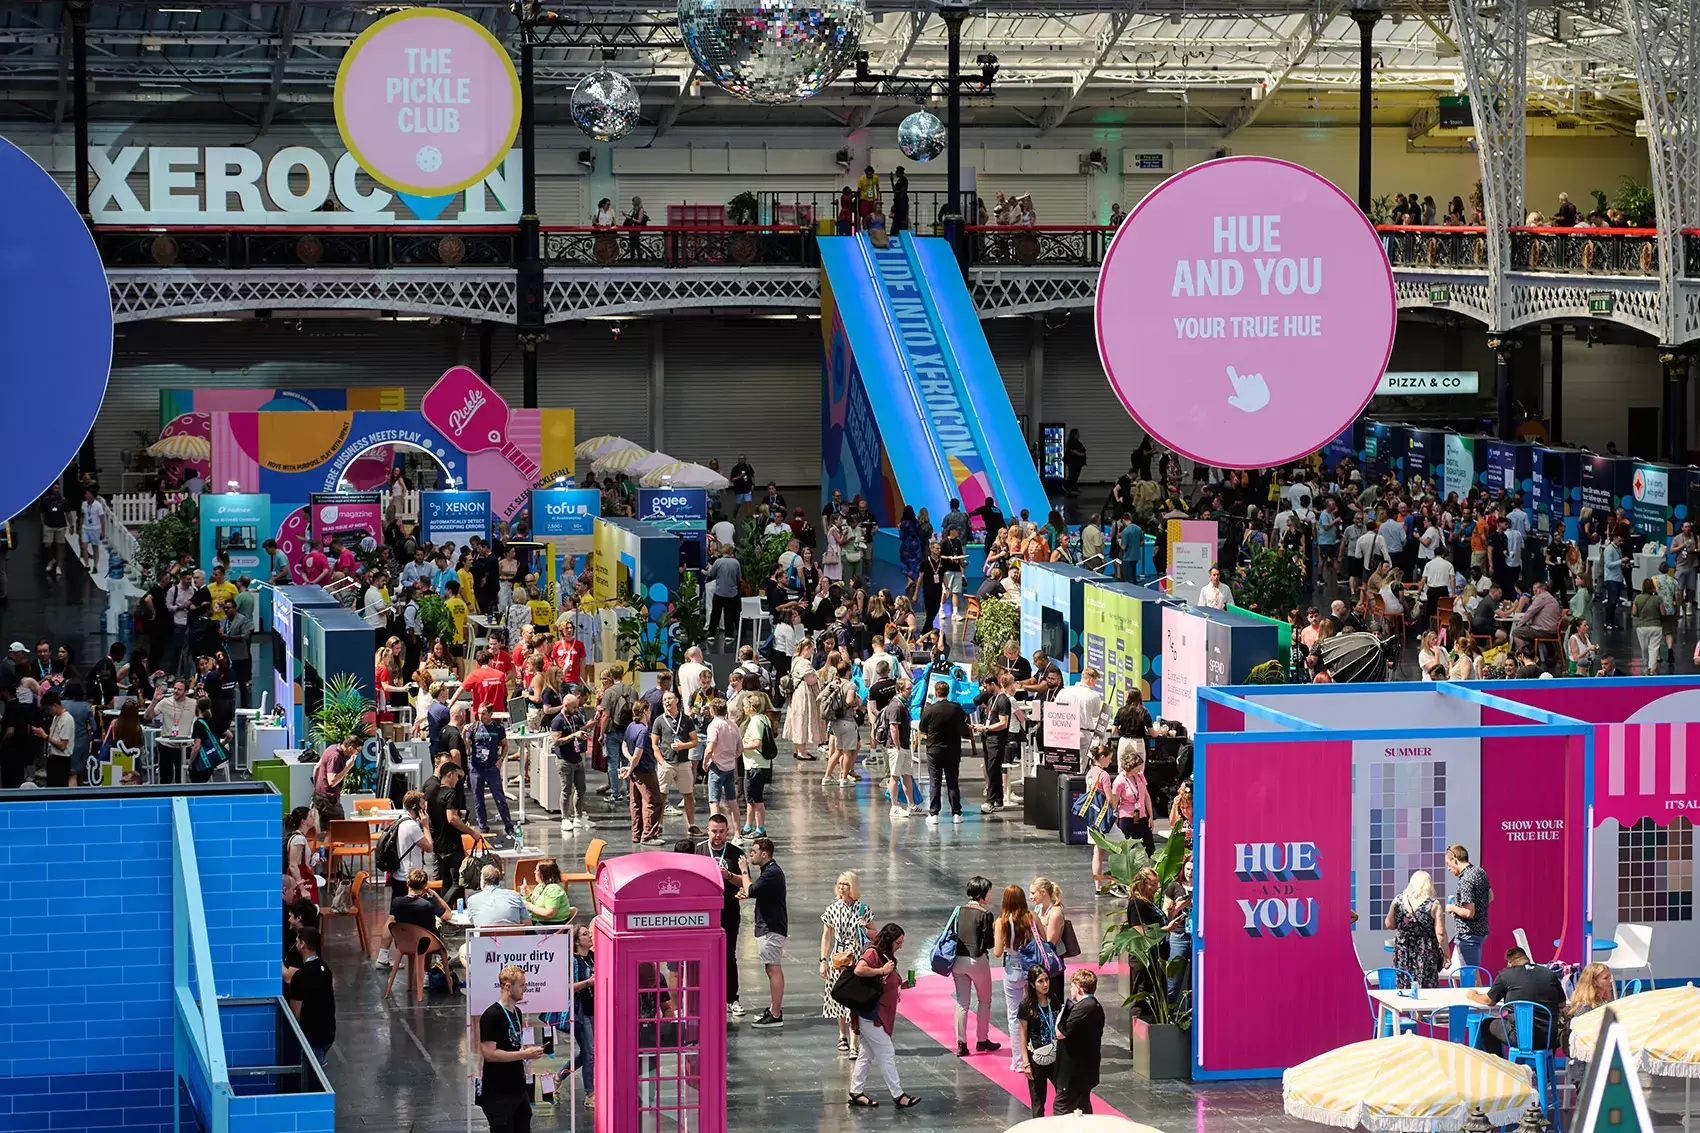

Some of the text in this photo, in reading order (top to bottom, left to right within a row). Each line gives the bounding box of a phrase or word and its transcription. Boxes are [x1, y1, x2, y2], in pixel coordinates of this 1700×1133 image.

[404, 48, 452, 74] THE
[386, 78, 470, 104] PICKLE
[397, 107, 460, 134] CLUB
[88, 146, 522, 213] XEROCN
[1212, 214, 1281, 253] HUE
[1171, 256, 1322, 297] AND YOU
[892, 297, 938, 351] INTO
[1173, 315, 1321, 339] YOUR TRUE HUE
[1388, 376, 1461, 388] PIZZA & CO
[449, 388, 486, 437] Pickle
[911, 349, 978, 458] XEROCON
[323, 429, 422, 493] HERE BUSINESS MEETS PLAY
[445, 501, 485, 512] XENON
[544, 501, 576, 515] tofu
[652, 496, 688, 513] gojee
[338, 511, 373, 519] magazine
[1047, 711, 1077, 721] COME ON
[1052, 720, 1072, 728] DOWN
[1384, 746, 1432, 757] SUMMER
[1501, 819, 1564, 831] SHOW YOUR
[1507, 830, 1560, 842] TRUE HUE
[1234, 841, 1320, 879] HUE
[1260, 884, 1295, 896] AND
[632, 915, 705, 927] TELEPHONE
[1236, 897, 1316, 935] YOU
[503, 952, 527, 964] your
[529, 949, 555, 963] dirty
